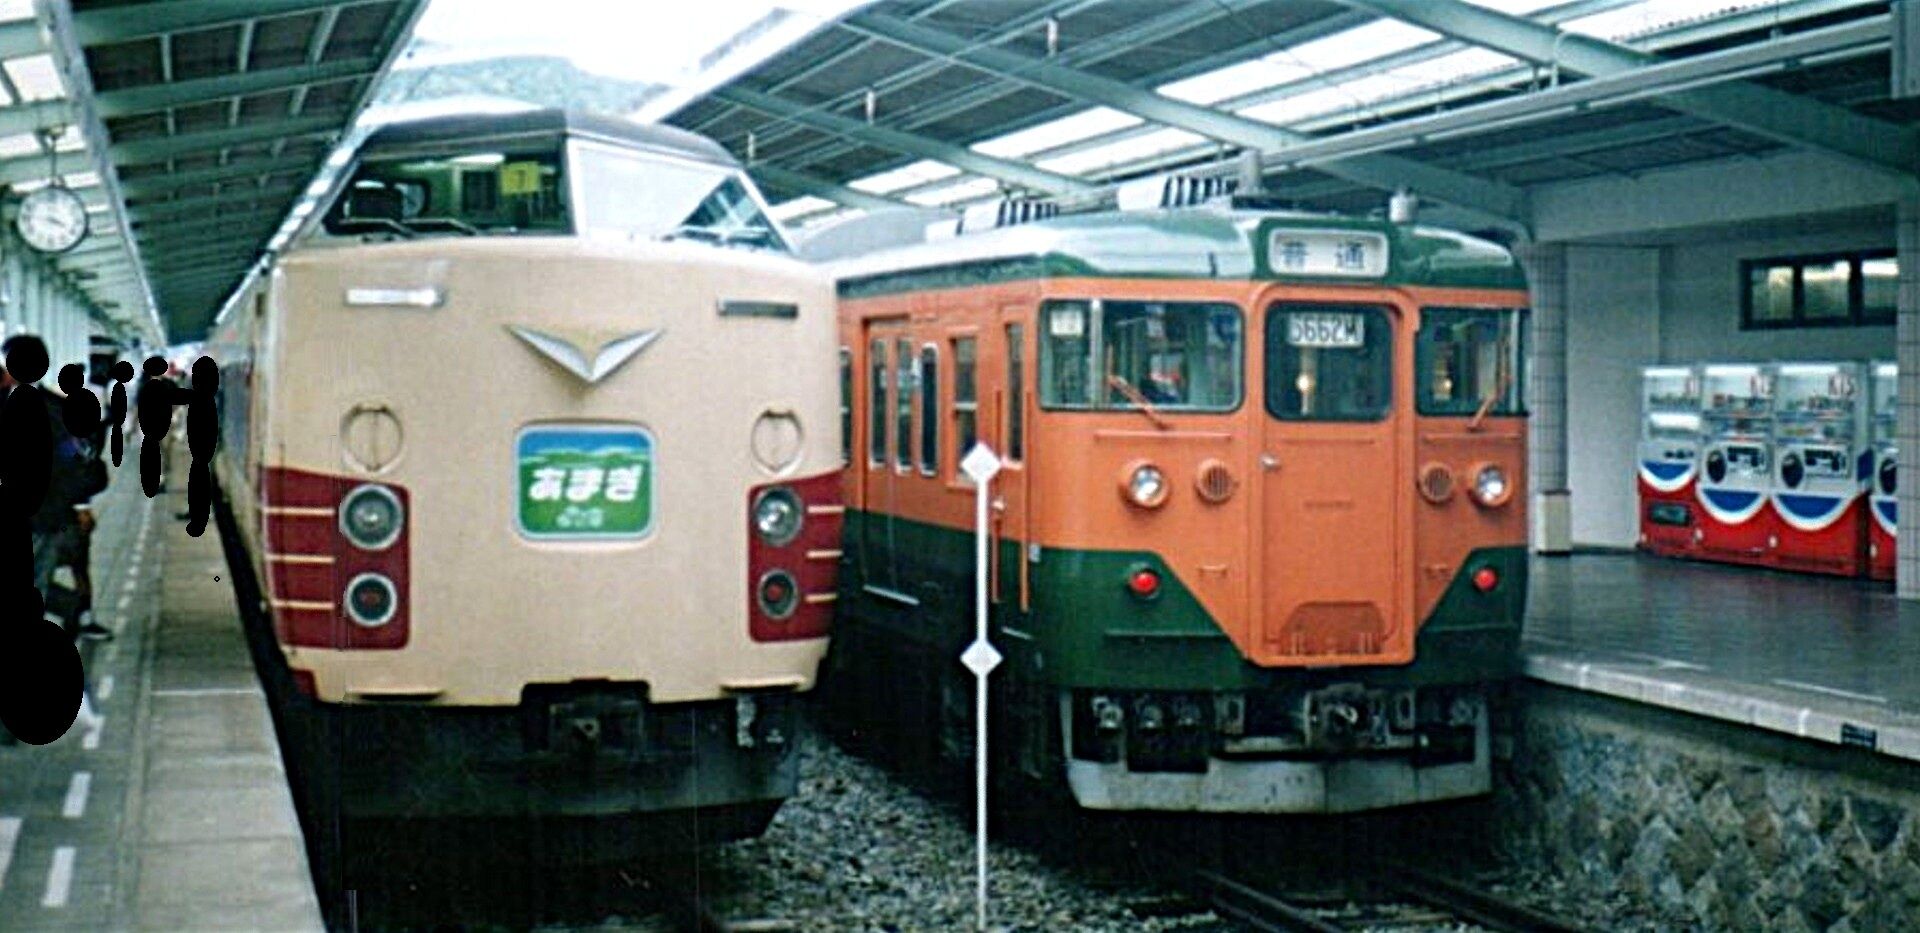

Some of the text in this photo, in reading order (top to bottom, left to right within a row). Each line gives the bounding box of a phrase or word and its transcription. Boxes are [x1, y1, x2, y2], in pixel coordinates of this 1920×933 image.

[1280, 240, 1365, 269] 普通
[528, 464, 643, 503] あまぎ
